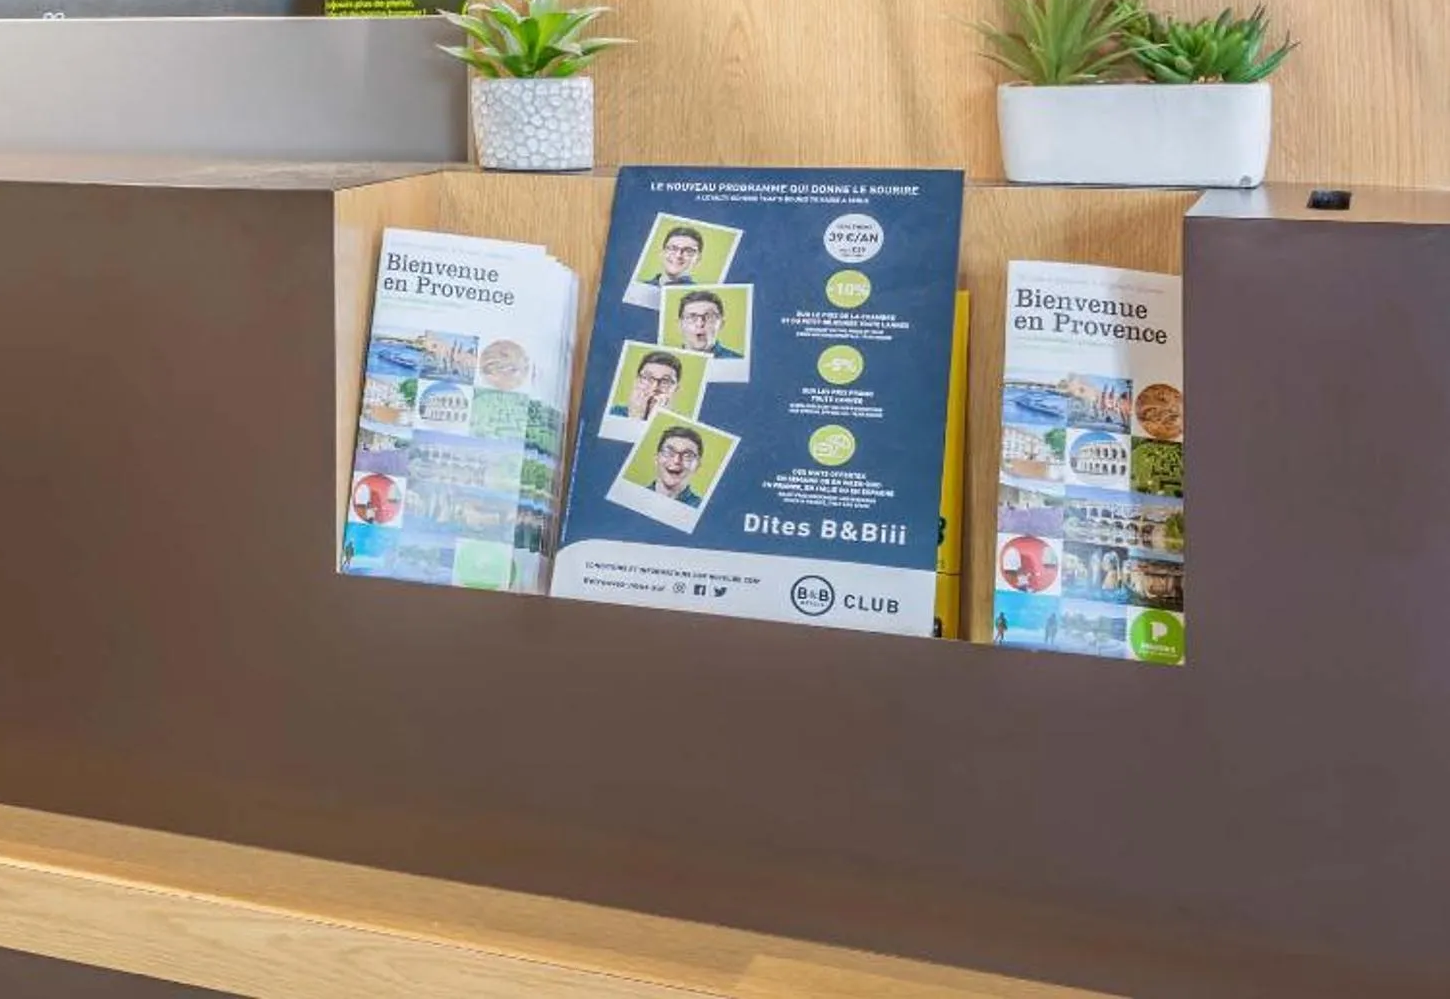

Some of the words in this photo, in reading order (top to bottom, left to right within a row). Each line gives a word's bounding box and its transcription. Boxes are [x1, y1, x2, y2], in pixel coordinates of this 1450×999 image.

[651, 182, 664, 192] LE
[666, 182, 716, 192] NOUVEAU
[718, 183, 789, 194] PROGRAMME
[790, 184, 809, 194] QUI
[811, 184, 851, 194] DONNE
[852, 185, 868, 194] LE
[869, 185, 921, 196] SOURIRE
[386, 252, 499, 283] Bienvenue
[383, 276, 407, 292] en
[416, 275, 515, 306] Provence
[1015, 288, 1148, 320] Bienvenue
[1014, 315, 1043, 331] en
[1052, 312, 1168, 344] Provence
[744, 513, 812, 537] Dites
[820, 519, 907, 545] B&Biii
[797, 586, 829, 602] B&B
[843, 594, 900, 614] CLUB
